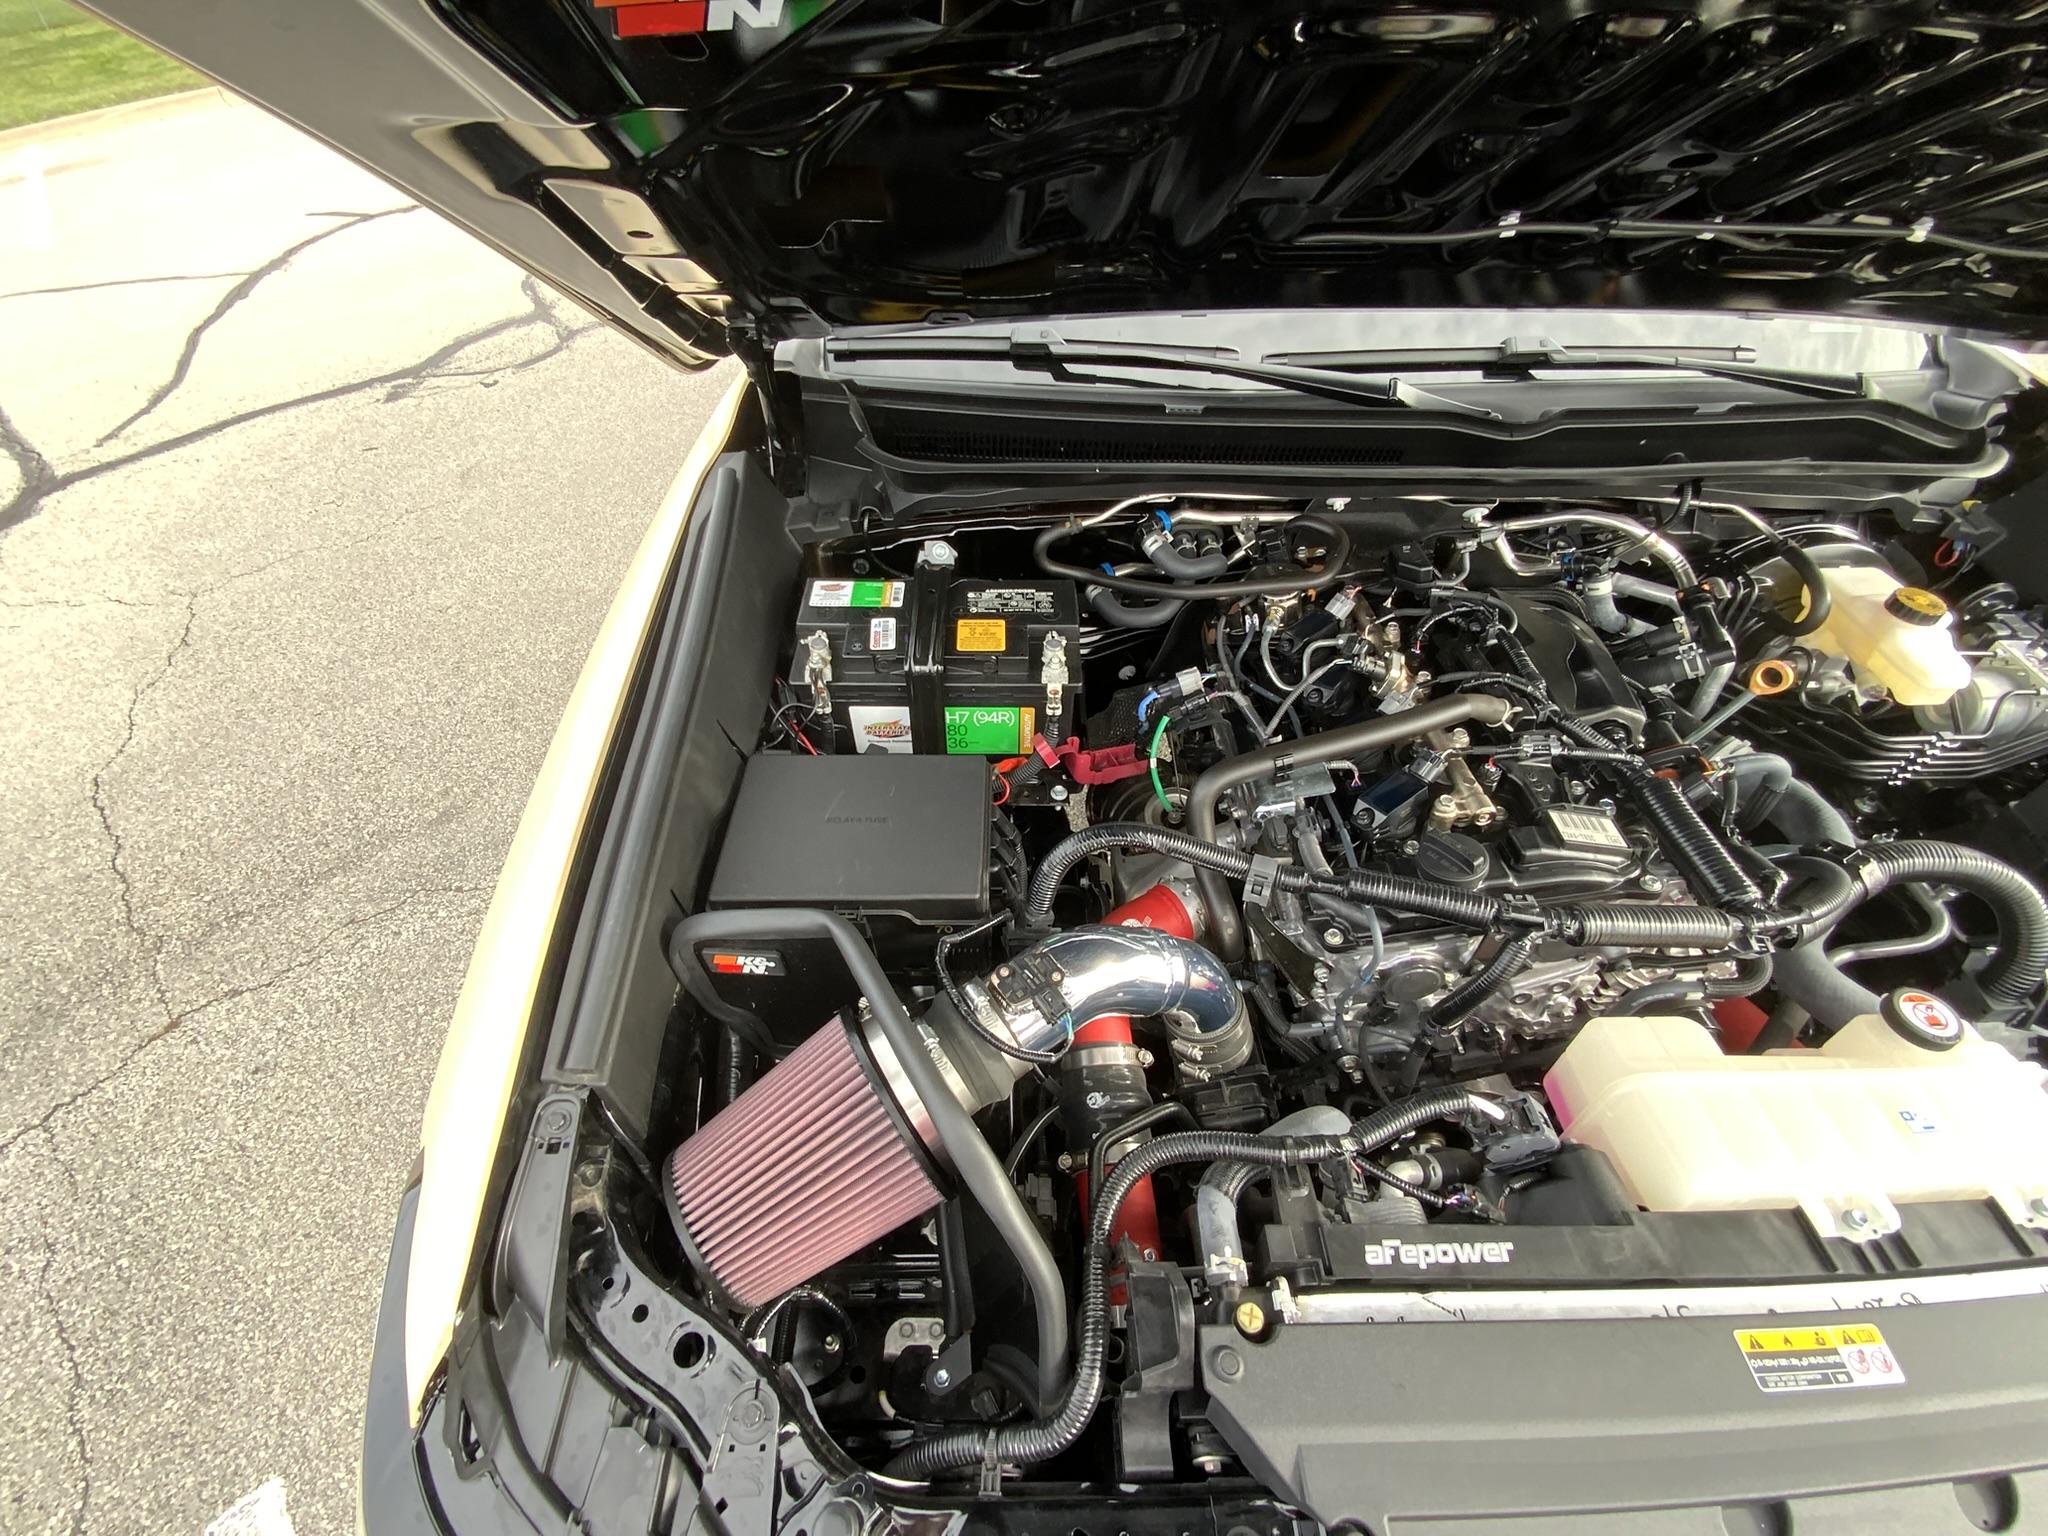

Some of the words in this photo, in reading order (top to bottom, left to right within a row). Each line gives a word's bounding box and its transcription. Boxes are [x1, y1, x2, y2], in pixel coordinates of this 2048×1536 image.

[945, 710, 969, 723] H7
[973, 709, 1015, 727] (94R)
[947, 723, 967, 736] 80
[948, 736, 968, 749] 36
